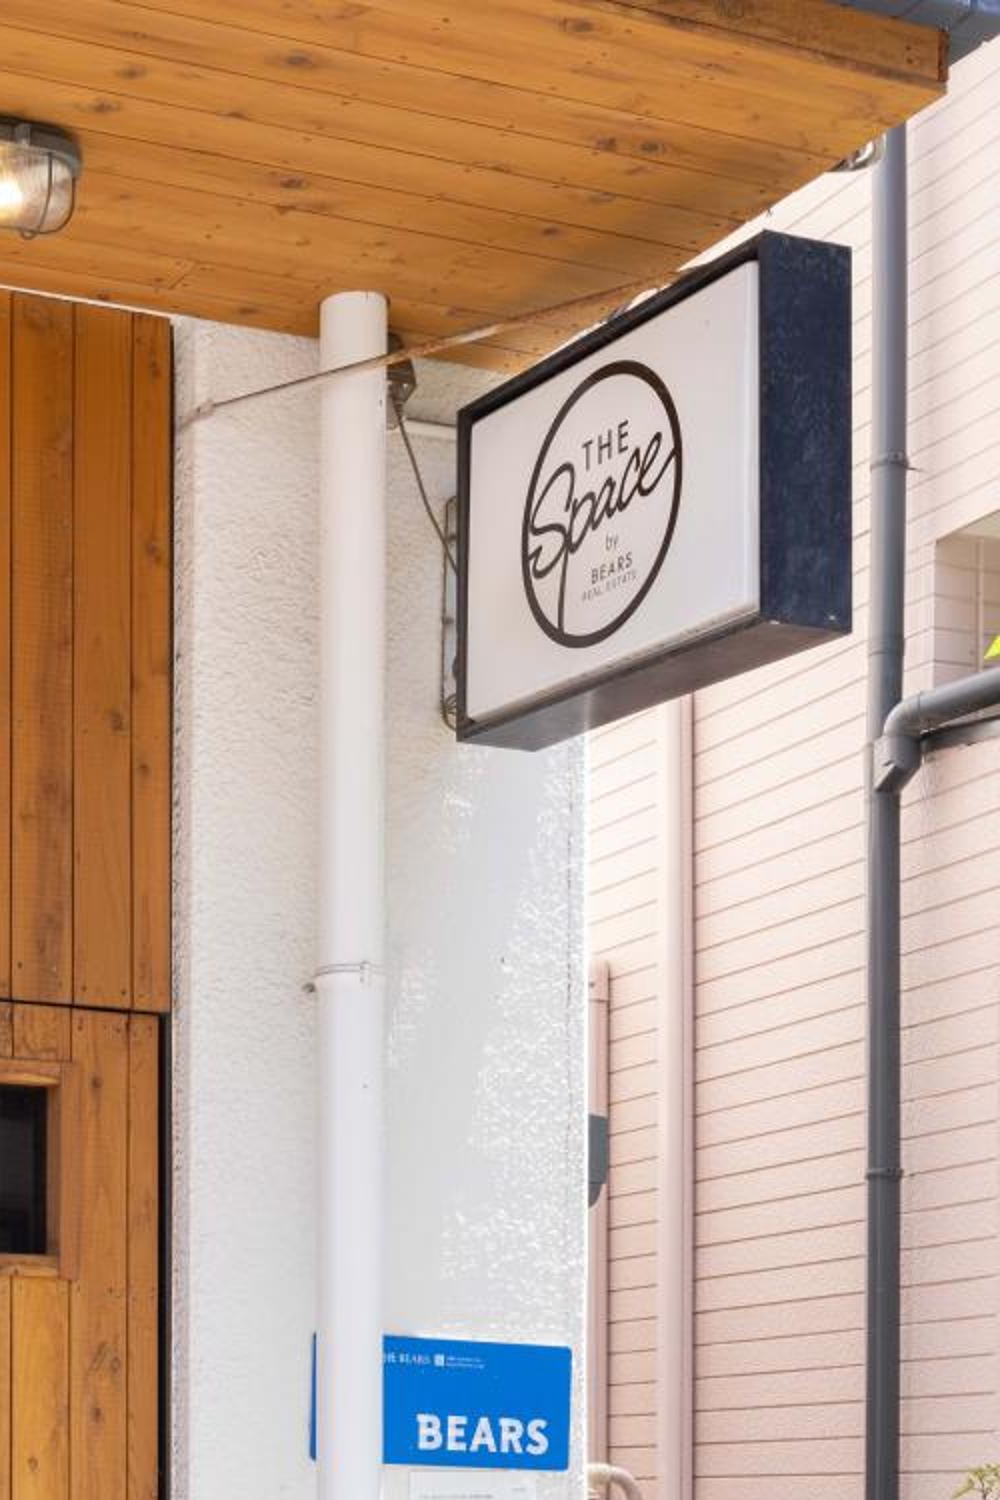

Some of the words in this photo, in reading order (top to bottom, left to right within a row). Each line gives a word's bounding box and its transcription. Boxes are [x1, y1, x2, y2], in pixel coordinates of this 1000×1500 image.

[582, 419, 629, 472] THE
[529, 431, 675, 633] Space
[605, 532, 619, 551] by
[591, 551, 633, 585] BEARS
[416, 1413, 549, 1456] BEARS
